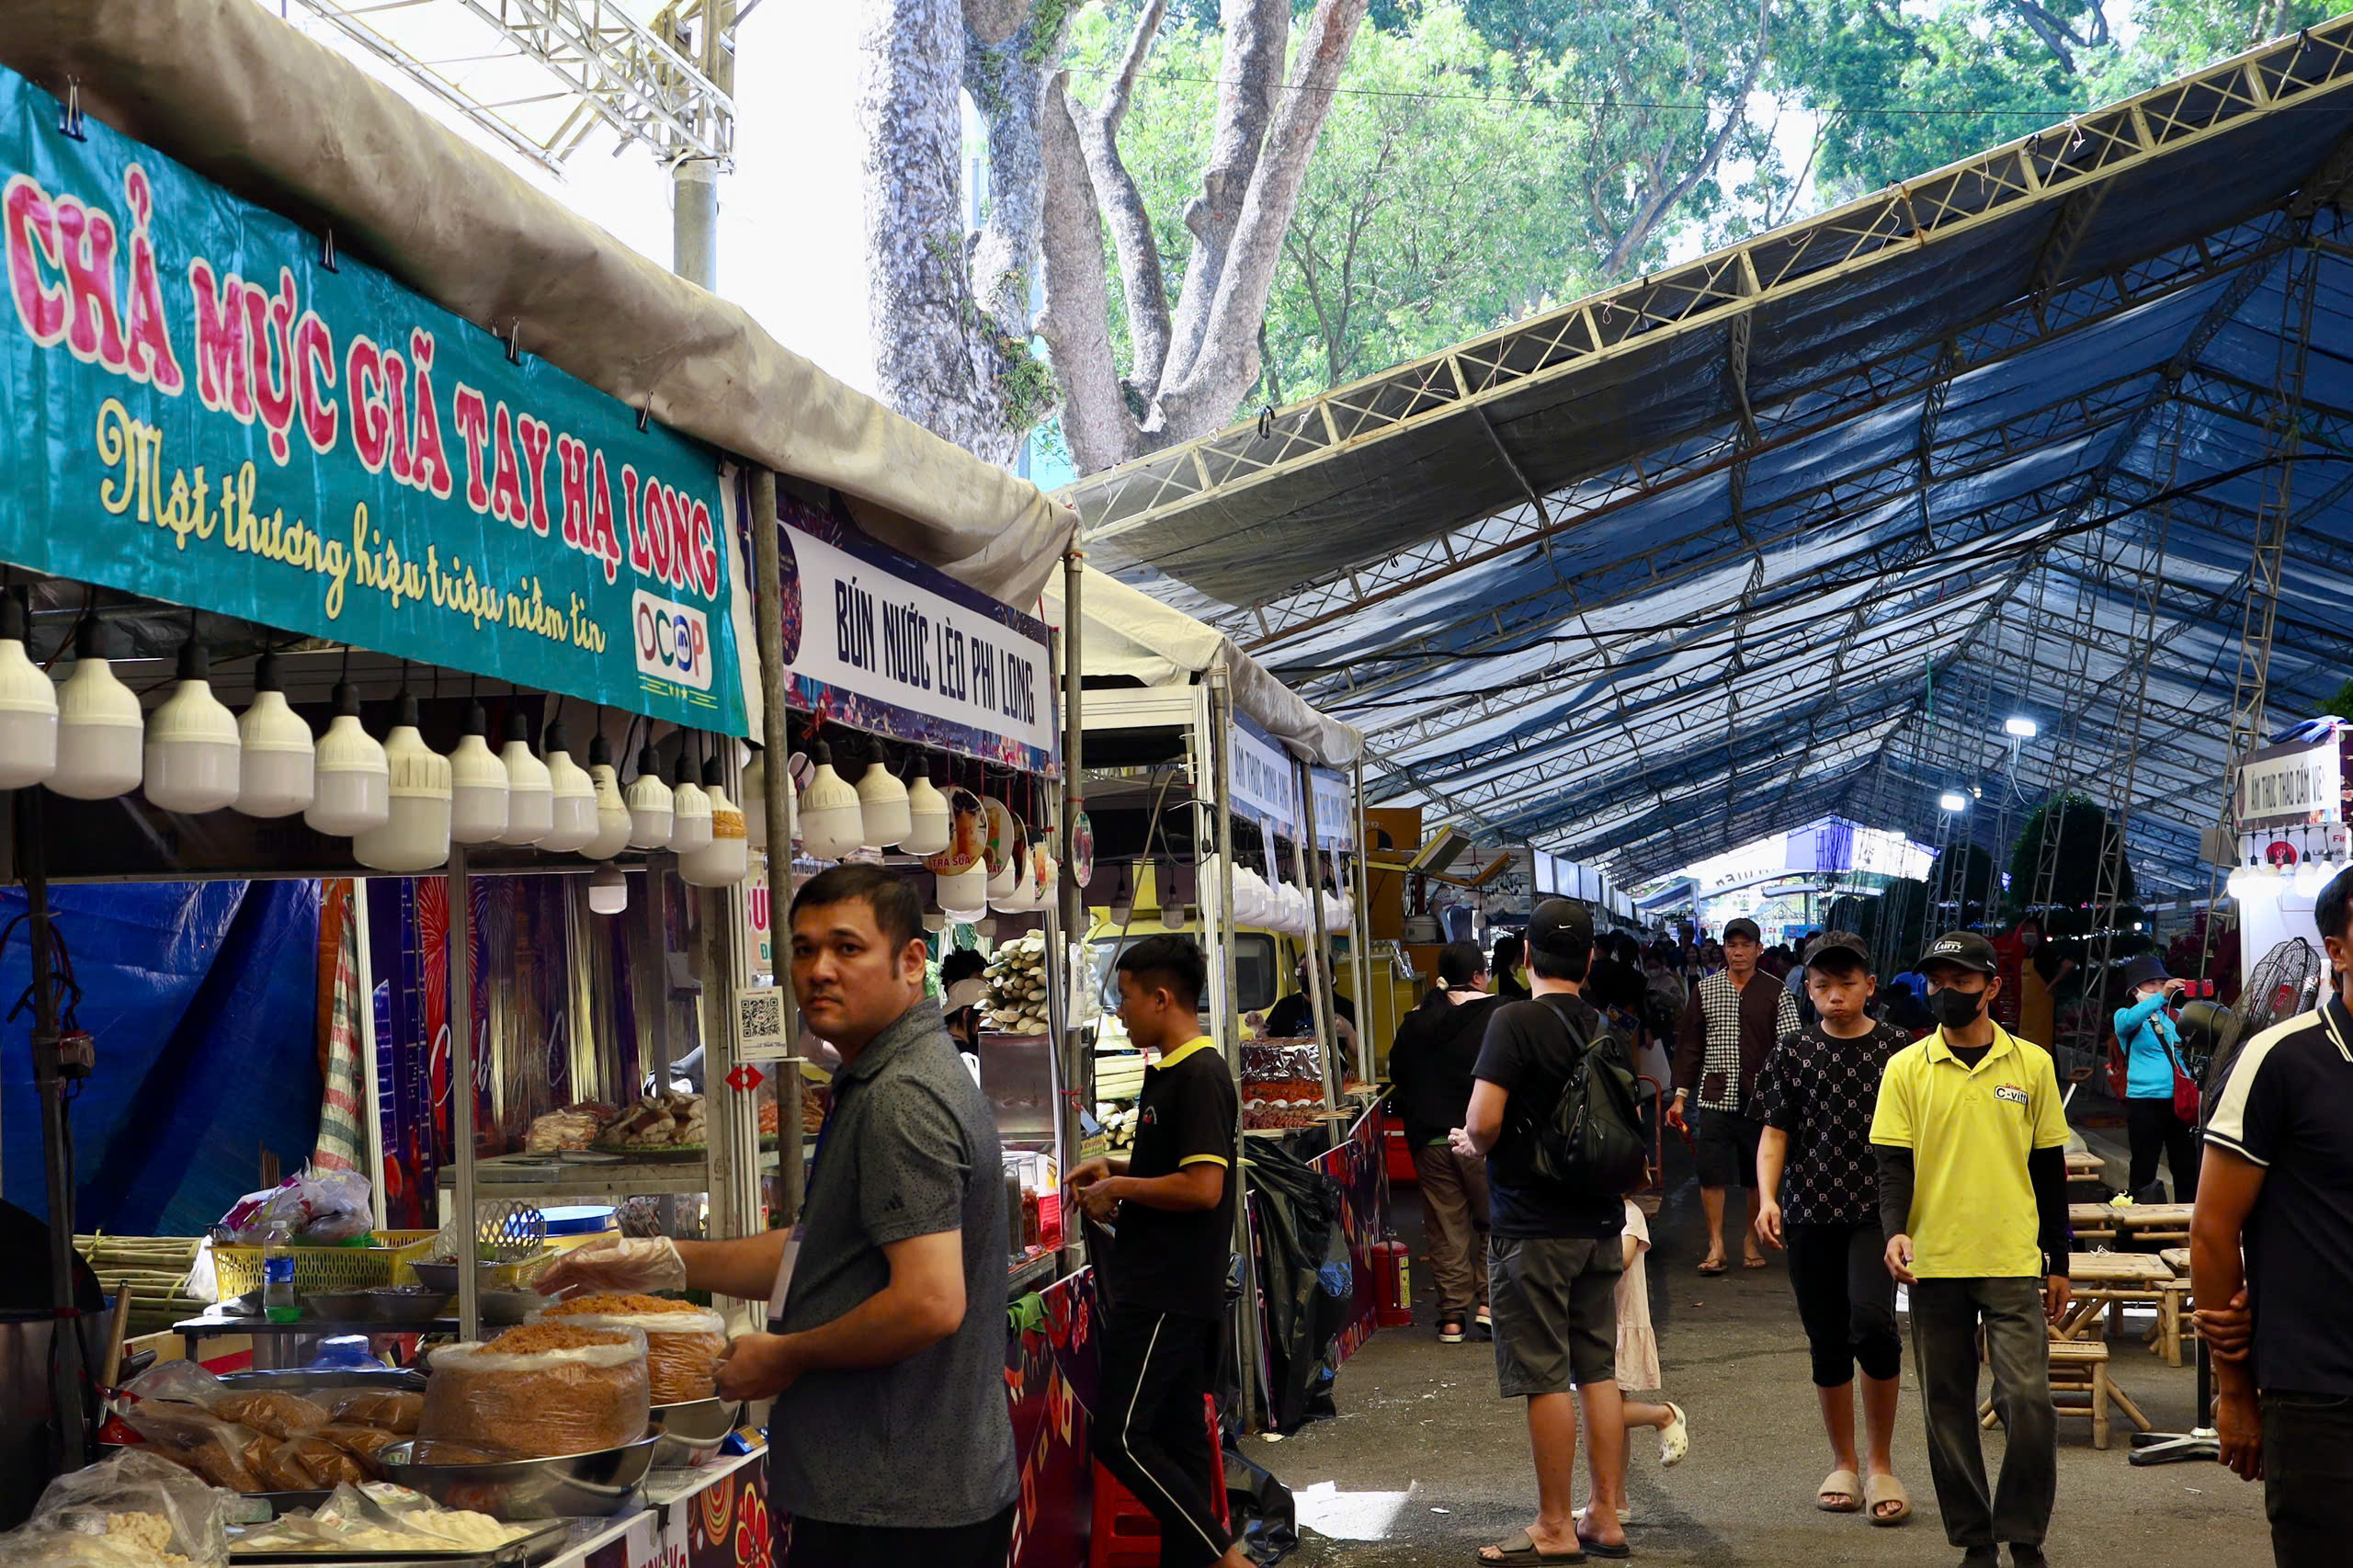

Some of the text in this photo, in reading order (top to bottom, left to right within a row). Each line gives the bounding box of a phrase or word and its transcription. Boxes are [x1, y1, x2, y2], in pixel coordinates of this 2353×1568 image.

[4, 163, 718, 602] CHẢ MỰC GIÃ TAY HẠ LONG
[96, 397, 218, 551] Một
[220, 460, 351, 619] thương
[354, 501, 426, 608] hiệu
[427, 544, 504, 631] triệu
[570, 591, 606, 654] tin
[637, 602, 704, 677] OCOP
[835, 576, 1035, 726] BÚN NƯỚC LÈO PHI LONG
[1934, 941, 1963, 951] Curry
